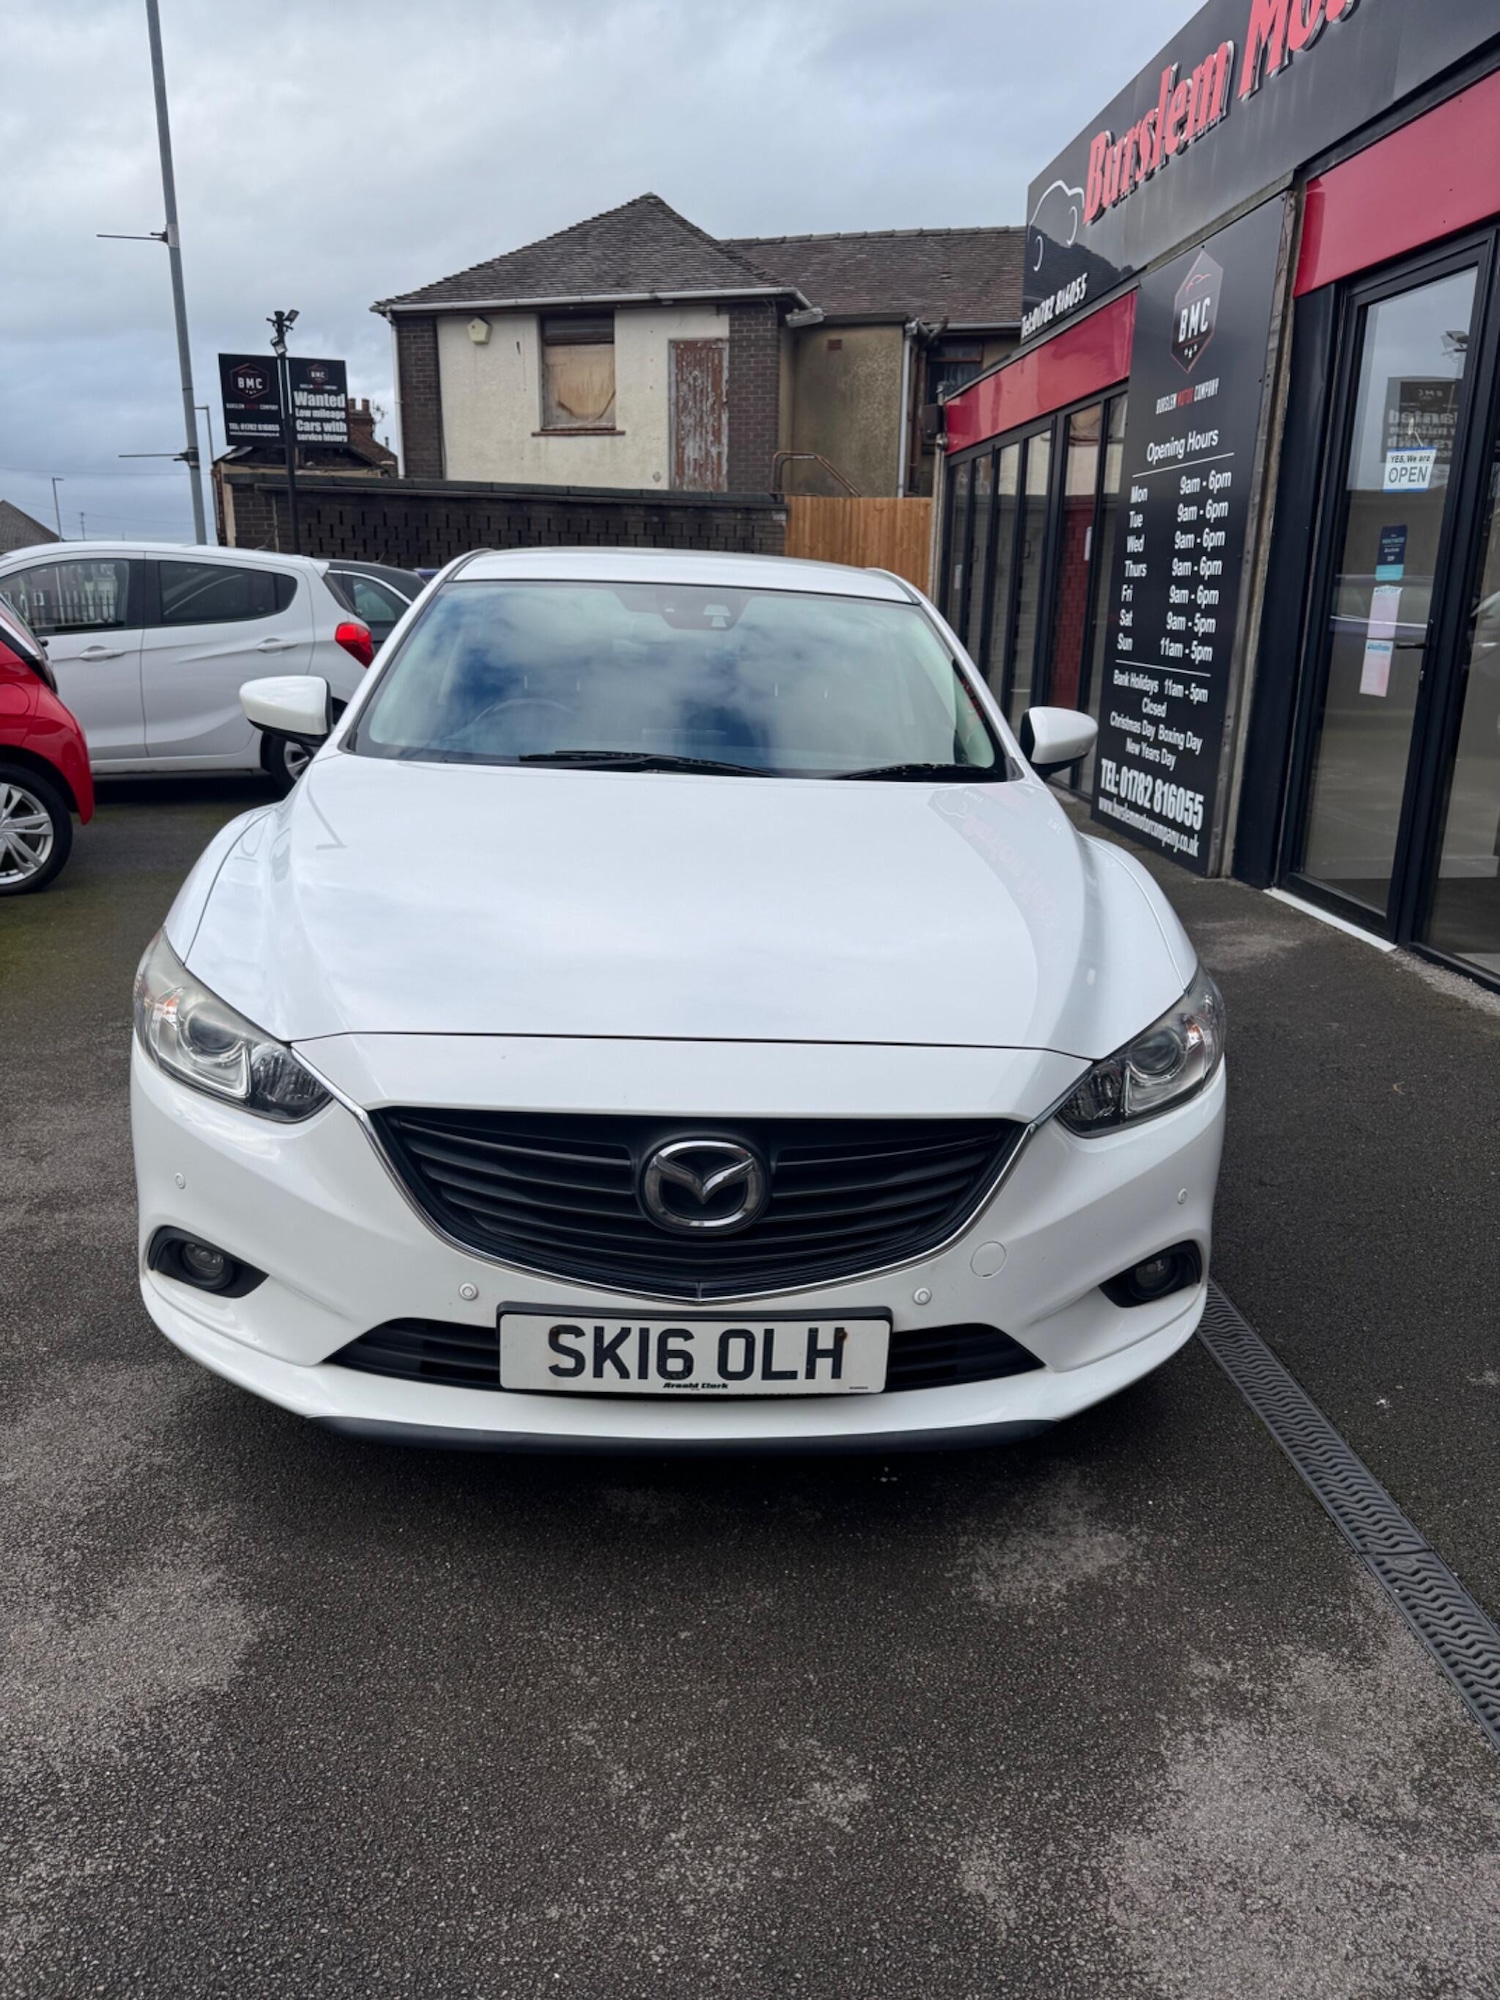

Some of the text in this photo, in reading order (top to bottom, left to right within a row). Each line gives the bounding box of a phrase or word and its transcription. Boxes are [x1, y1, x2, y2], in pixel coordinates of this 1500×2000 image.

[1083, 0, 1357, 226] Burslem Mo
[1055, 272, 1088, 316] 816055
[1178, 296, 1211, 343] BMC
[237, 377, 263, 389] BMC
[293, 390, 346, 408] Wanted
[295, 408, 346, 420] Low mileage
[296, 420, 347, 433] Cars with
[297, 432, 348, 443] service history
[1146, 429, 1219, 465] Opening Hours
[1391, 455, 1406, 464] YES,
[1130, 486, 1149, 504] Mon
[1179, 475, 1200, 495] 9am
[1208, 469, 1232, 497] 6pm
[1388, 464, 1429, 485] OPEN
[1129, 510, 1143, 528] Tue
[1177, 502, 1198, 522] 9am
[1205, 499, 1229, 526] 6pm
[1126, 534, 1145, 553] Wed
[1174, 530, 1195, 550] 9am
[1202, 529, 1225, 556] 6pm
[1124, 560, 1147, 578] Thurs
[1171, 557, 1193, 577] 9am
[1199, 556, 1223, 580] 6pm
[1121, 584, 1133, 602] Fri
[1169, 585, 1190, 604] 9am
[1196, 585, 1219, 608] 6pm
[1119, 609, 1133, 627] Sat
[1166, 612, 1186, 631] 9am
[1193, 614, 1216, 634] 5pm
[1116, 633, 1133, 652] Sun
[1160, 637, 1183, 658] 11am
[1190, 642, 1213, 663] 5pm
[1113, 669, 1130, 689] Bank
[1130, 672, 1159, 694] Holidays
[1164, 678, 1184, 698] 11am
[1189, 683, 1208, 704] 5pm
[1141, 698, 1167, 718] Closed
[1109, 711, 1203, 756] Christmas Day Boxing Day
[1125, 737, 1176, 772] New Years Day
[1101, 758, 1204, 831] TEL: 01782 816055
[548, 1324, 848, 1381] SK16 OLH
[663, 1381, 729, 1389] Arnold Clark
